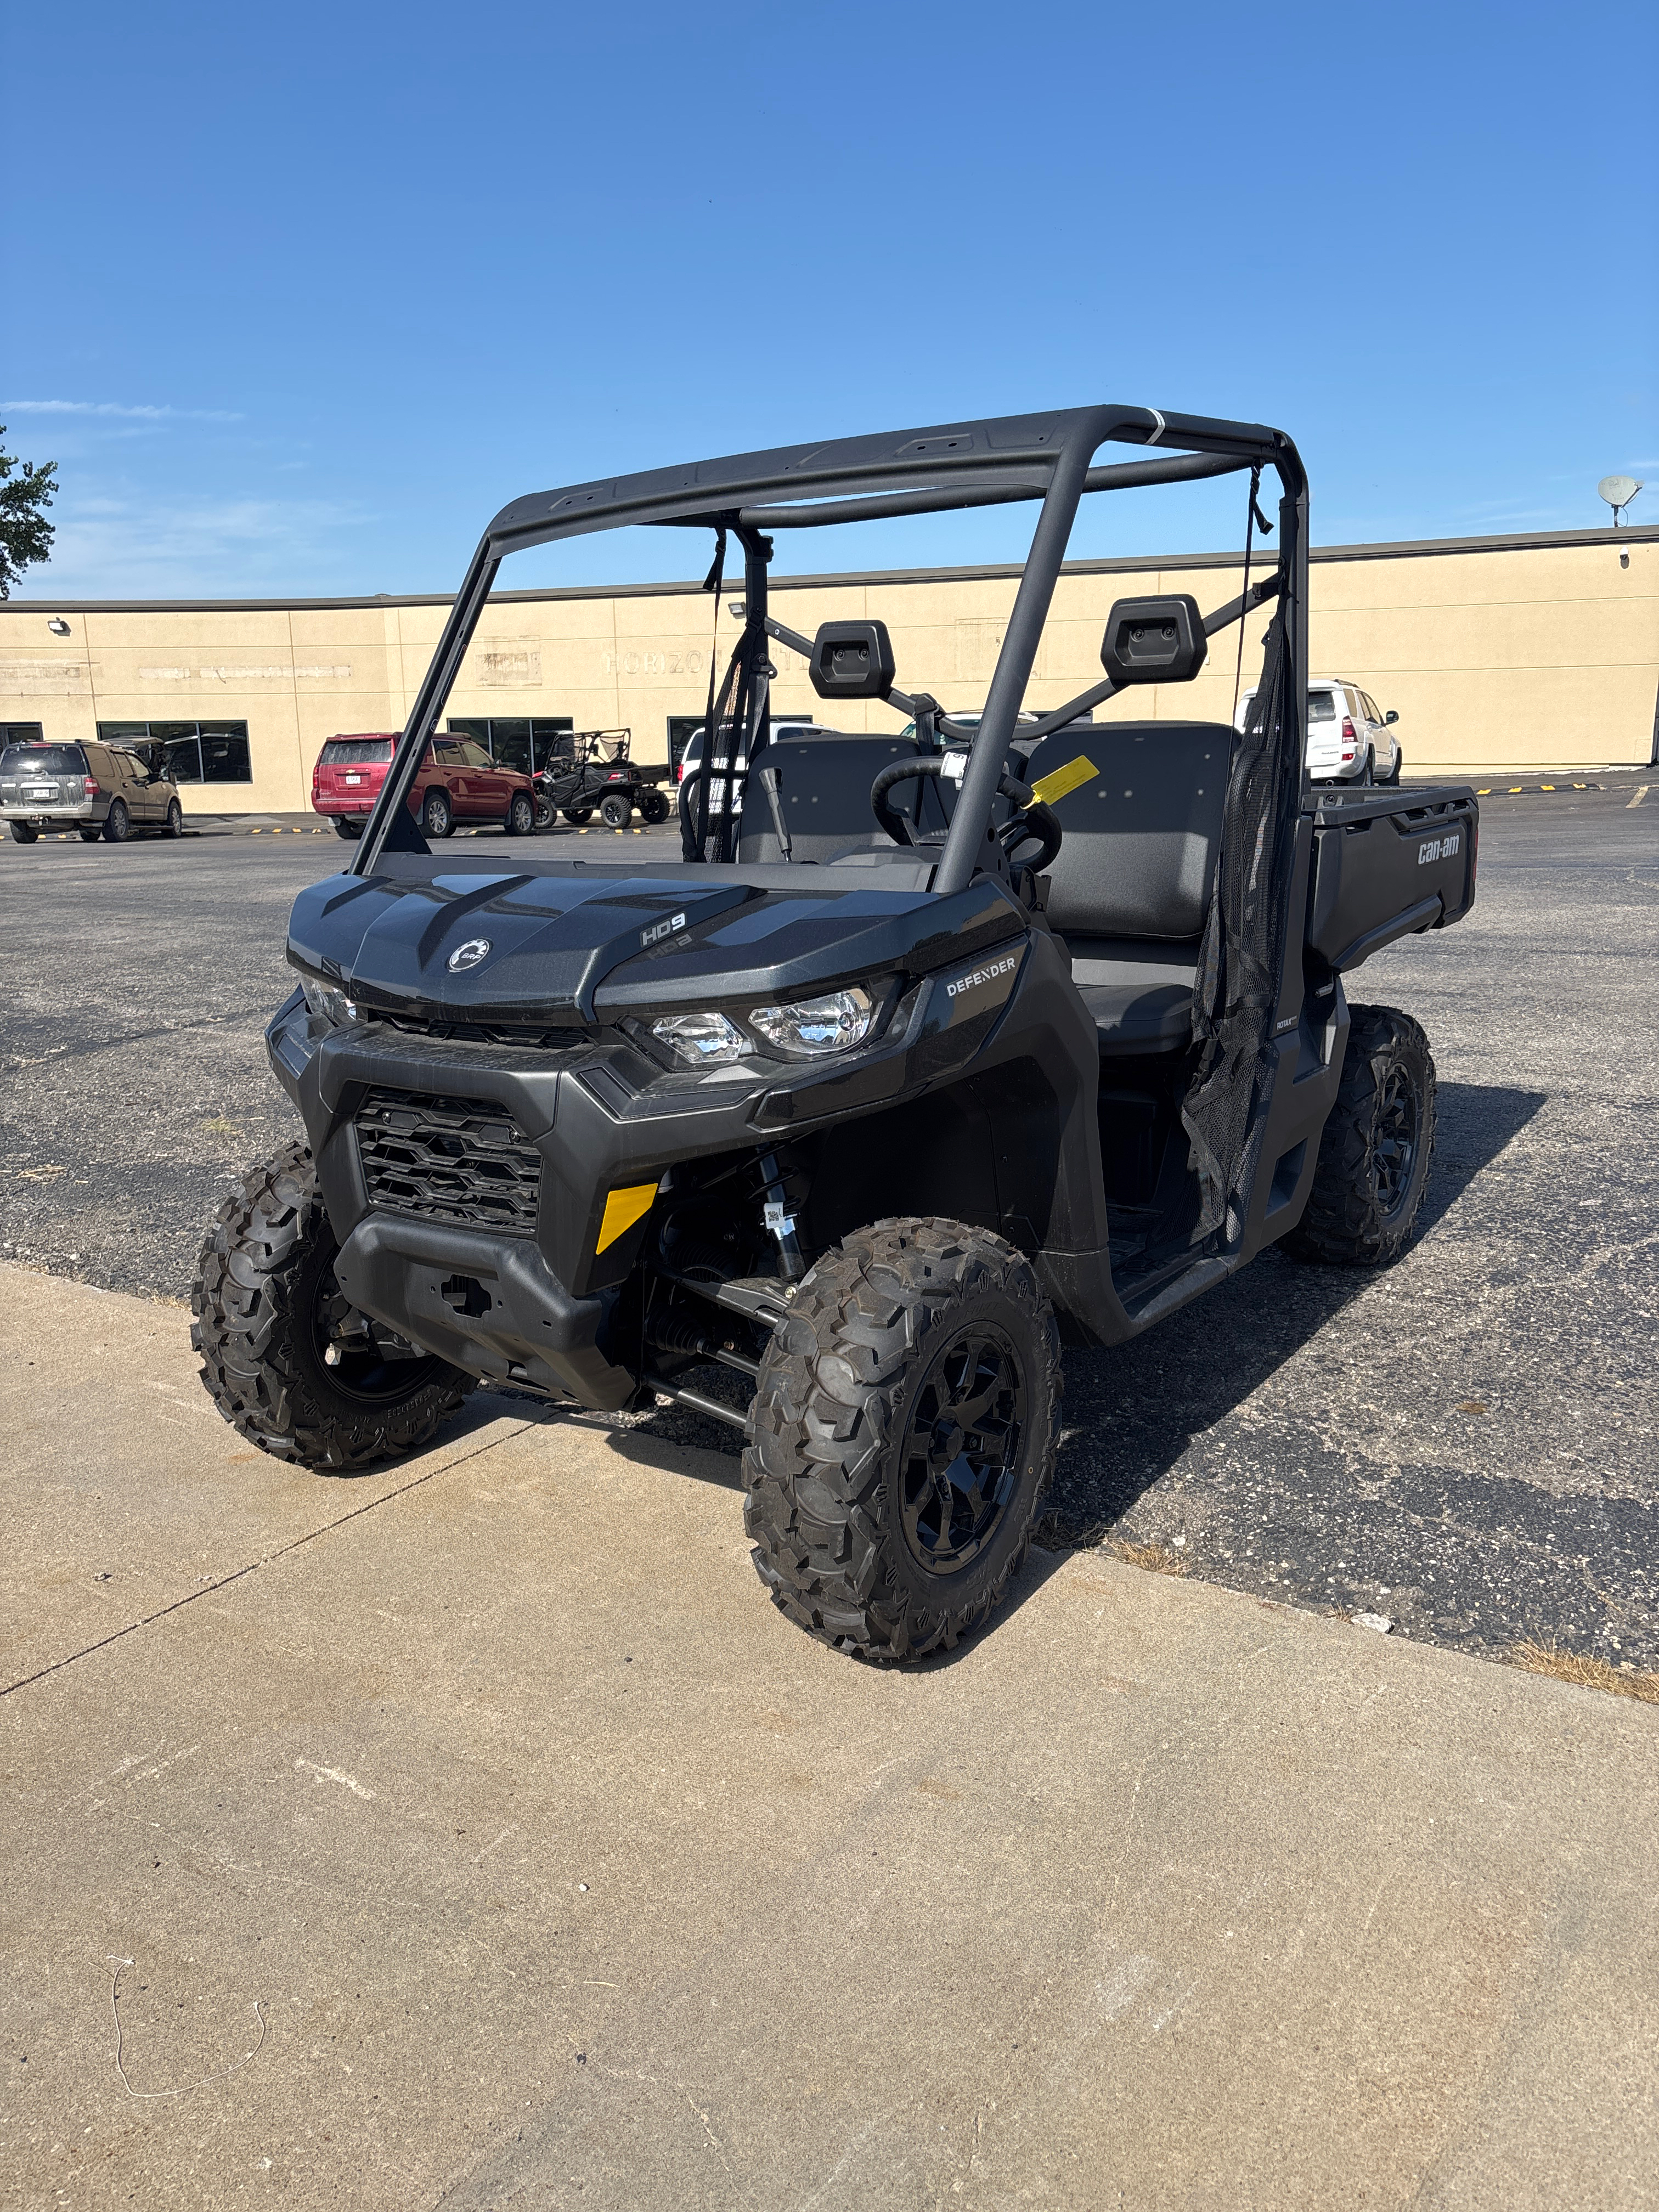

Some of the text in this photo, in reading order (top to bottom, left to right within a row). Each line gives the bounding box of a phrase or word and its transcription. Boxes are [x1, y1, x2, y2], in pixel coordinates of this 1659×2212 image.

[1418, 834, 1459, 865] can-am
[642, 912, 686, 946] HD9
[946, 957, 1015, 997] DEFENDER
[1277, 1018, 1291, 1030] ROTAX
